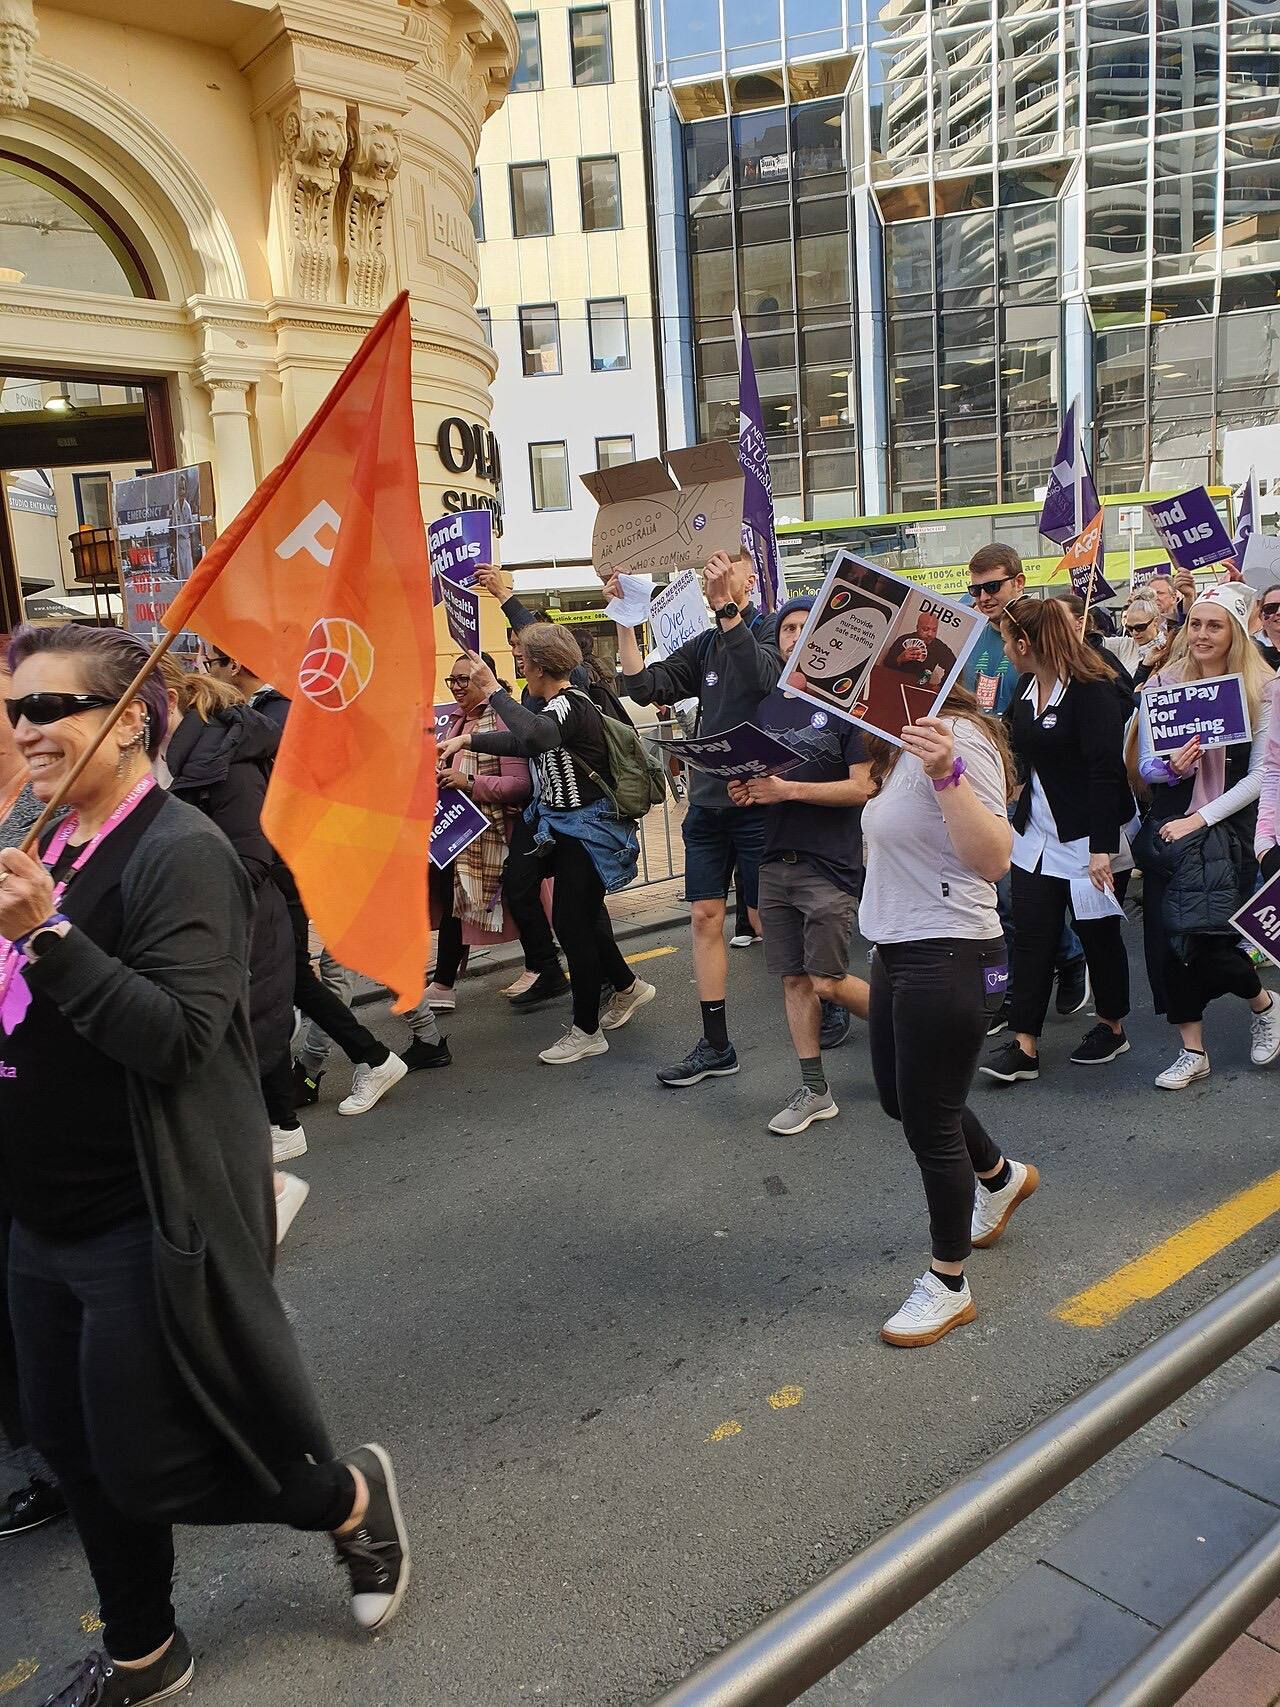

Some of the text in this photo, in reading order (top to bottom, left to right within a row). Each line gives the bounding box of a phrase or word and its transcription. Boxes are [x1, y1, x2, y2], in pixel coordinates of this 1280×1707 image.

[9, 497, 58, 513] STUDIO ENTRANCE
[429, 516, 463, 553] tand
[1182, 521, 1214, 545] us
[455, 542, 481, 562] us
[928, 569, 954, 580] 100%
[1025, 563, 1041, 572] are
[665, 569, 693, 599] MEMBERS
[651, 576, 694, 619] STANDING STRONG
[660, 604, 686, 639] Over
[849, 613, 874, 630] Provide
[919, 598, 962, 629] DHBs
[835, 626, 875, 650] safe staffing
[839, 619, 876, 640] nurses with
[807, 641, 830, 657] draw
[807, 653, 827, 671] 25
[1146, 685, 1220, 708] Fair Pay
[1150, 708, 1178, 724] for
[1152, 717, 1226, 741] Nursing
[691, 739, 733, 753] Pay
